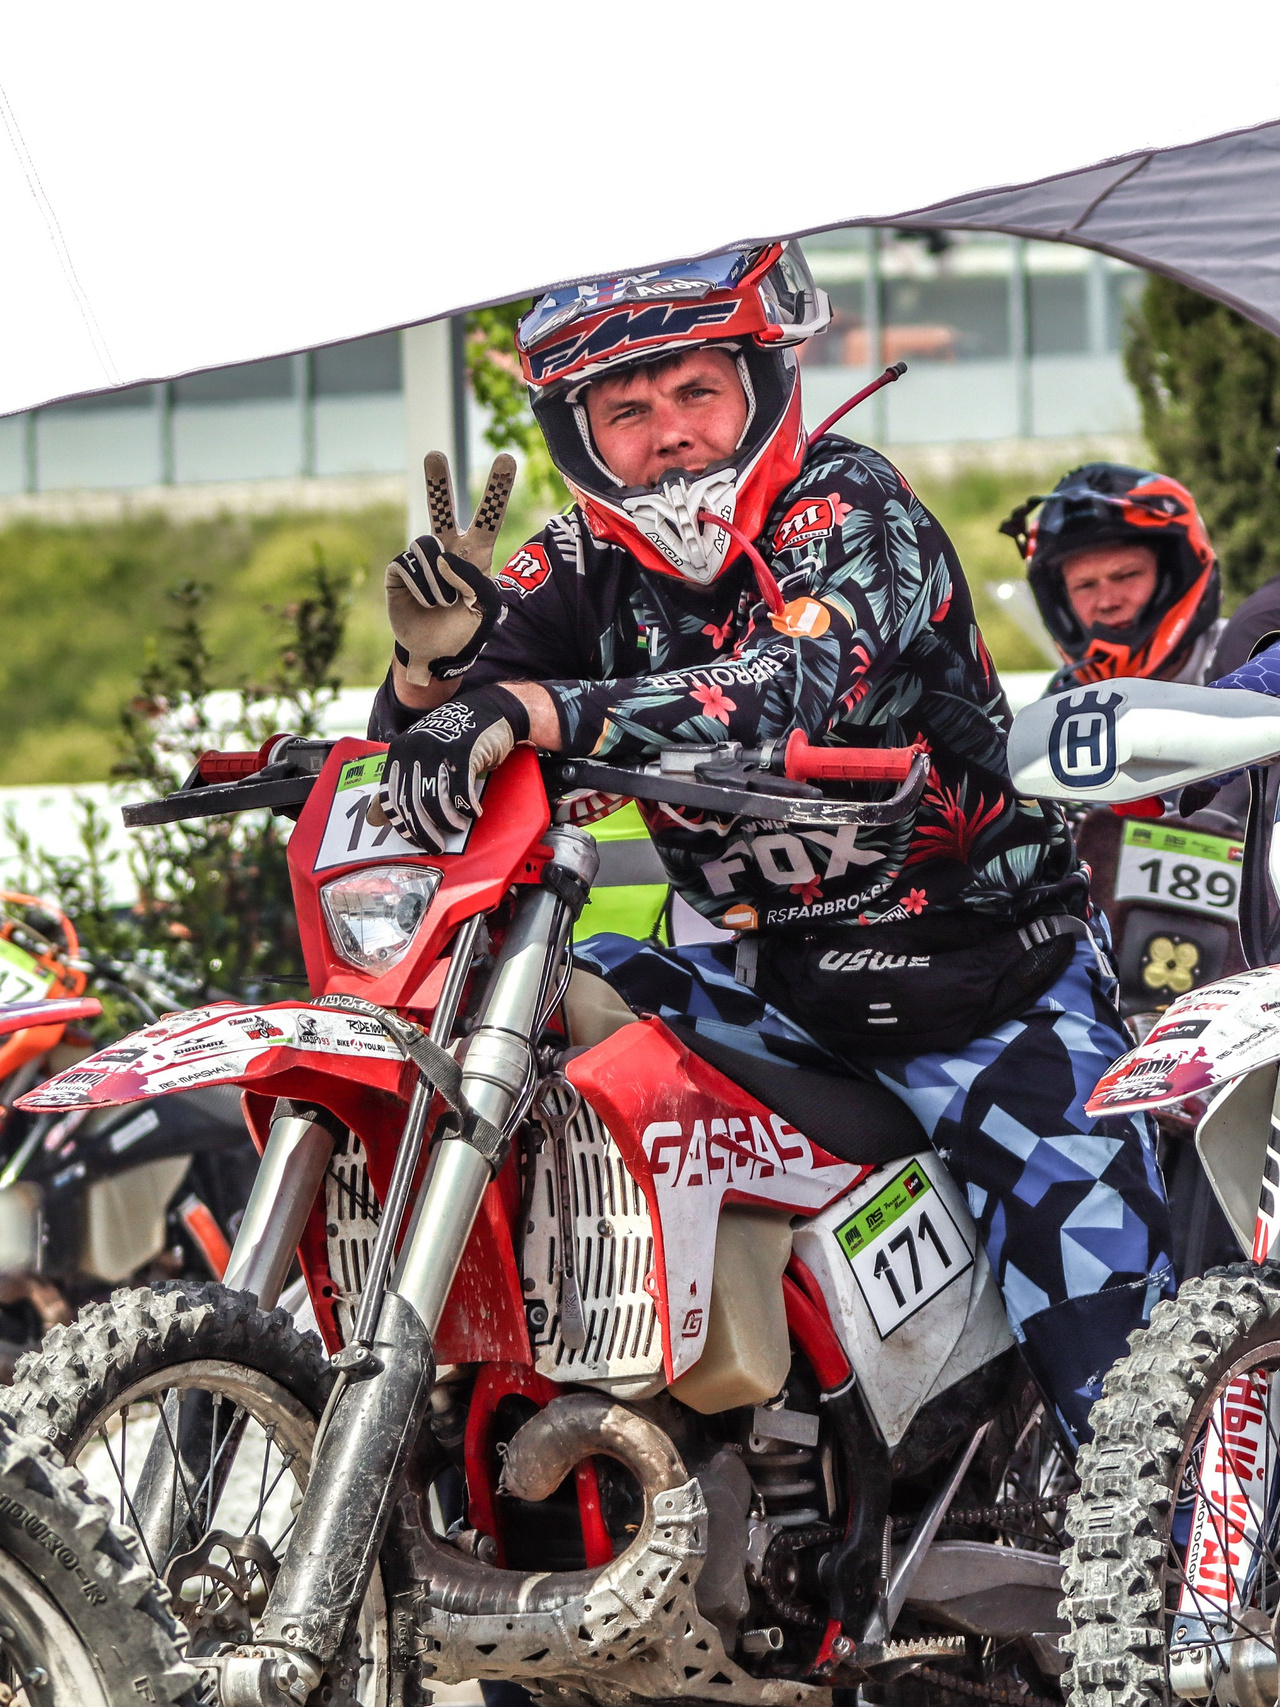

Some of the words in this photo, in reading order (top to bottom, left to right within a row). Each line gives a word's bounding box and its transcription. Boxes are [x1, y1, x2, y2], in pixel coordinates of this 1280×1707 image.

[635, 278, 711, 297] Airoh
[526, 298, 743, 381] FMF
[700, 824, 888, 897] FOX
[1138, 858, 1237, 908] 189
[1195, 989, 1241, 997] KENDA
[1157, 1025, 1196, 1037] LAVR
[173, 1038, 225, 1056] SHARMAX
[159, 1065, 231, 1089] MS-MARSHAL
[554, 1121, 564, 1129] 27
[873, 1210, 953, 1309] 171
